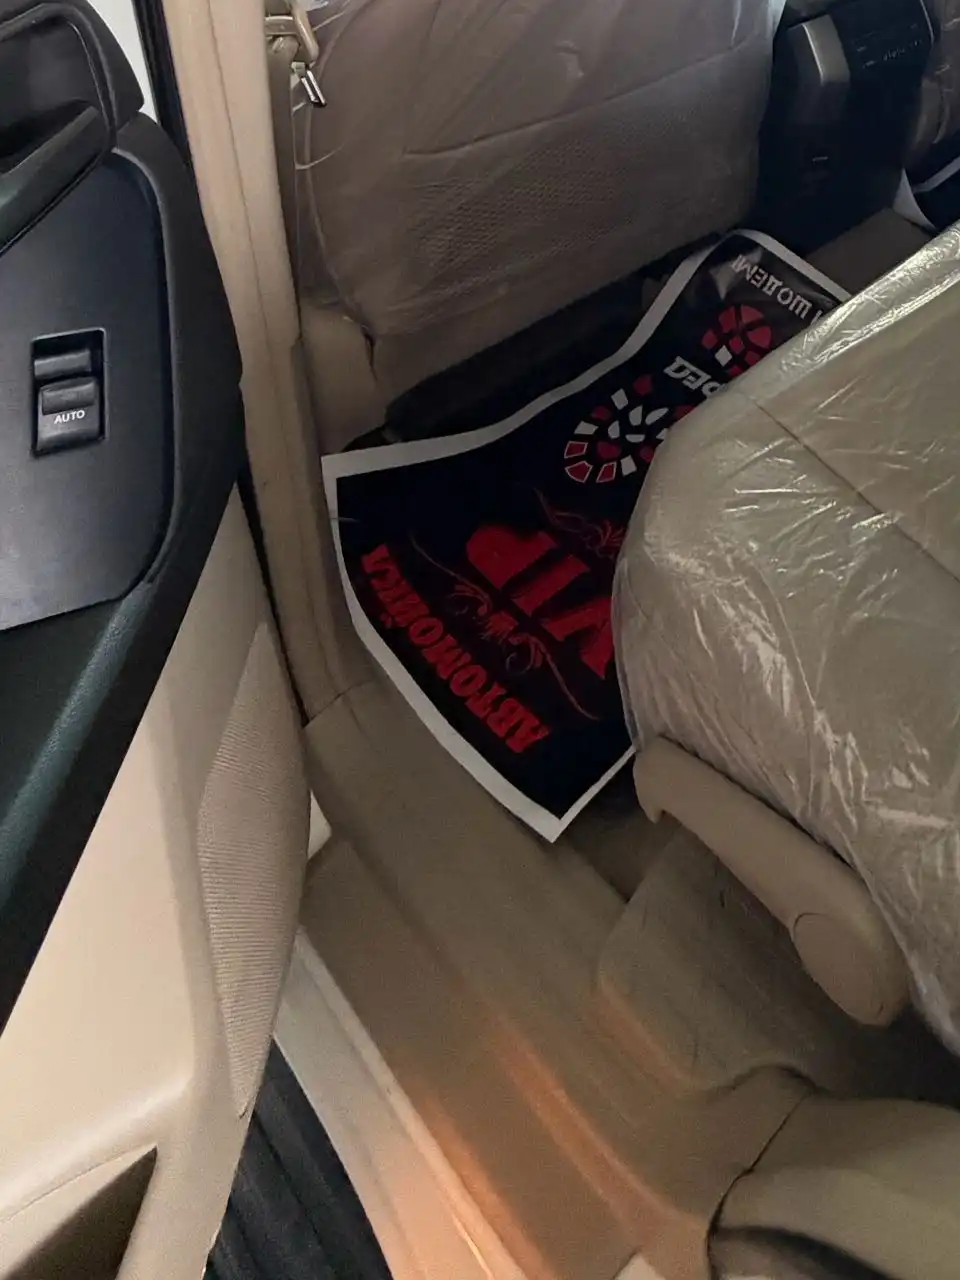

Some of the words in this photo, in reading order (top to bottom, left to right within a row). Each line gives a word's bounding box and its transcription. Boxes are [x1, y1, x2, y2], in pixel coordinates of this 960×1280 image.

[54, 410, 85, 425] AUTO
[361, 543, 550, 754] АВТОМОЙКА
[466, 525, 615, 680] VIP
